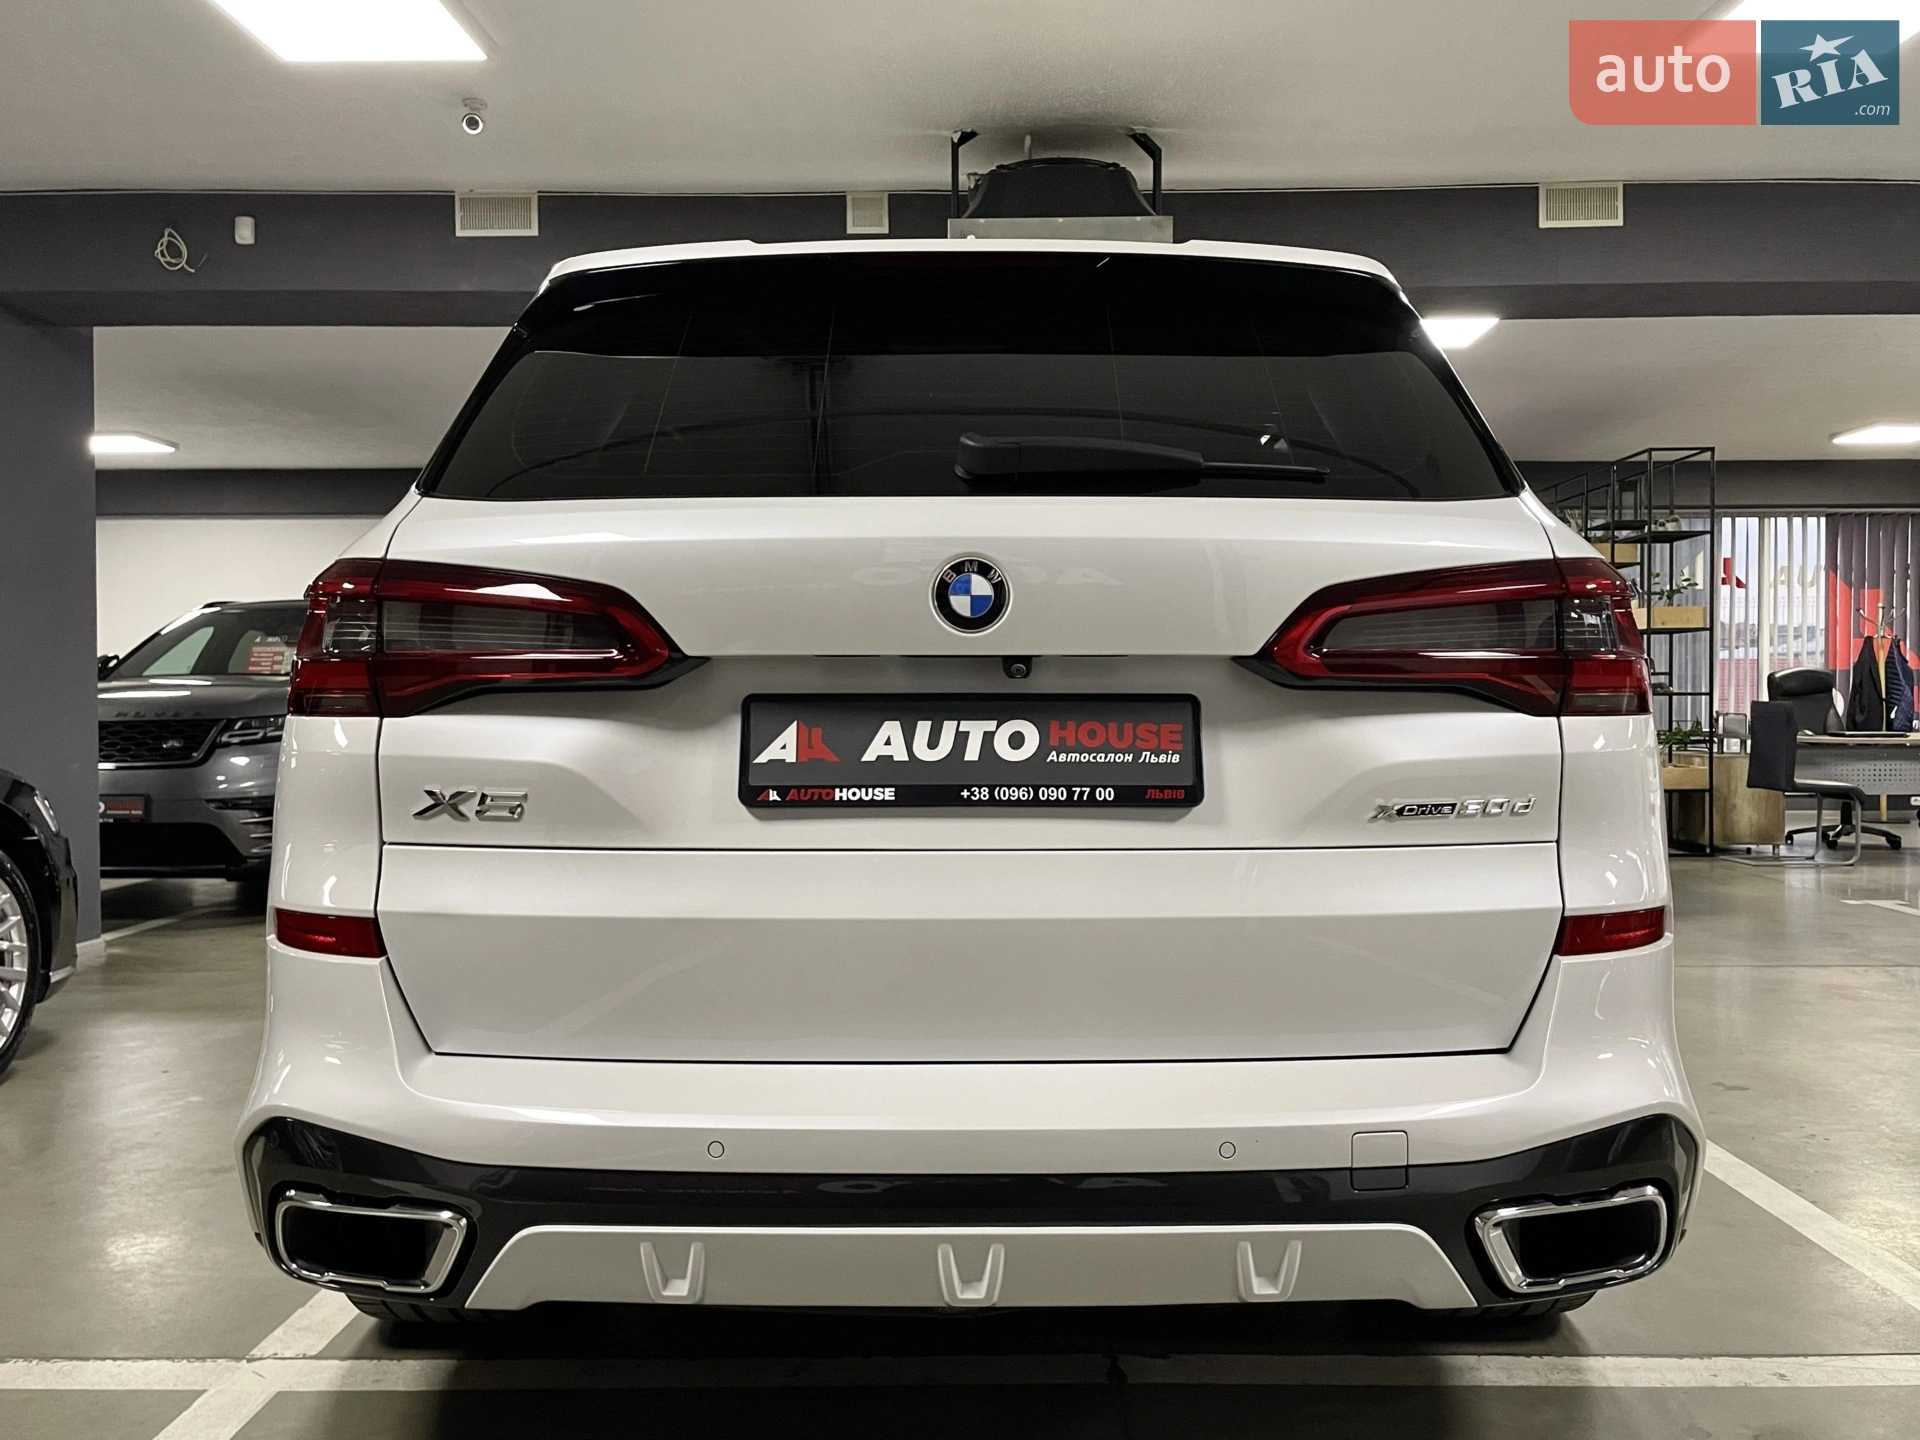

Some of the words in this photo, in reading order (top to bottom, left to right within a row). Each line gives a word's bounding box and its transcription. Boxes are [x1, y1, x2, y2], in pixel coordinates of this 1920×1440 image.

[942, 561, 1002, 584] BMW
[860, 719, 1040, 762] AUTO
[1049, 720, 1184, 750] HOUSE
[1046, 750, 1133, 763] Автосалон
[1138, 751, 1181, 764] Львів
[786, 788, 896, 801] AUTOHOUSE
[960, 787, 990, 800] +38
[994, 786, 1034, 801] (096)
[1038, 787, 1067, 801] 090
[1071, 787, 1091, 800] 77
[1095, 787, 1115, 801] 00
[412, 789, 528, 821] X5
